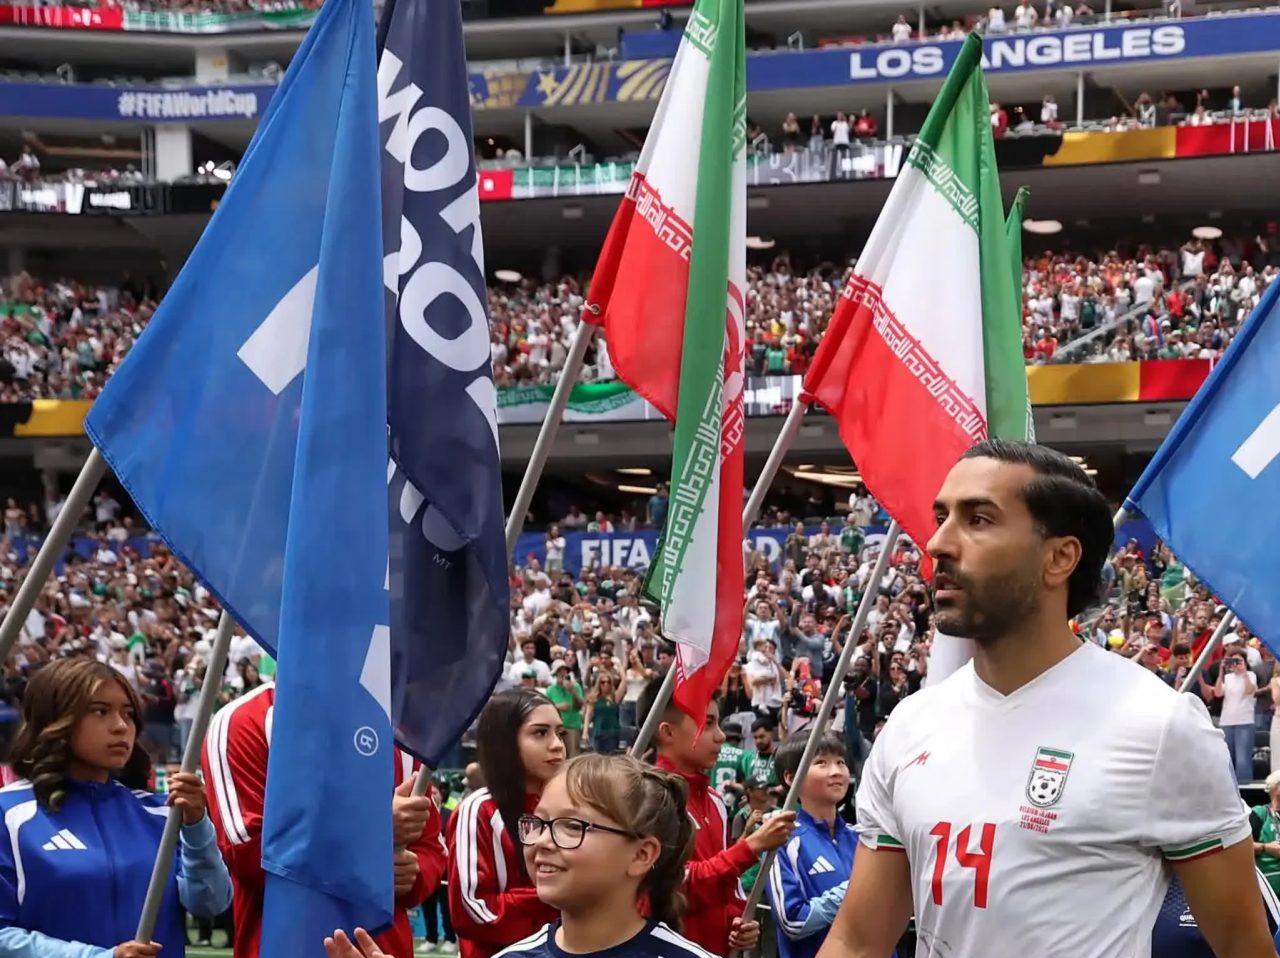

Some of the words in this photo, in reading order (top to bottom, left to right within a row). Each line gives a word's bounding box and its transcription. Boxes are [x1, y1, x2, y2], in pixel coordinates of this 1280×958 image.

[850, 46, 944, 79] LOS
[118, 90, 258, 118] #FIFAWorldCup
[580, 538, 655, 569] FIFA
[929, 821, 997, 909] 14
